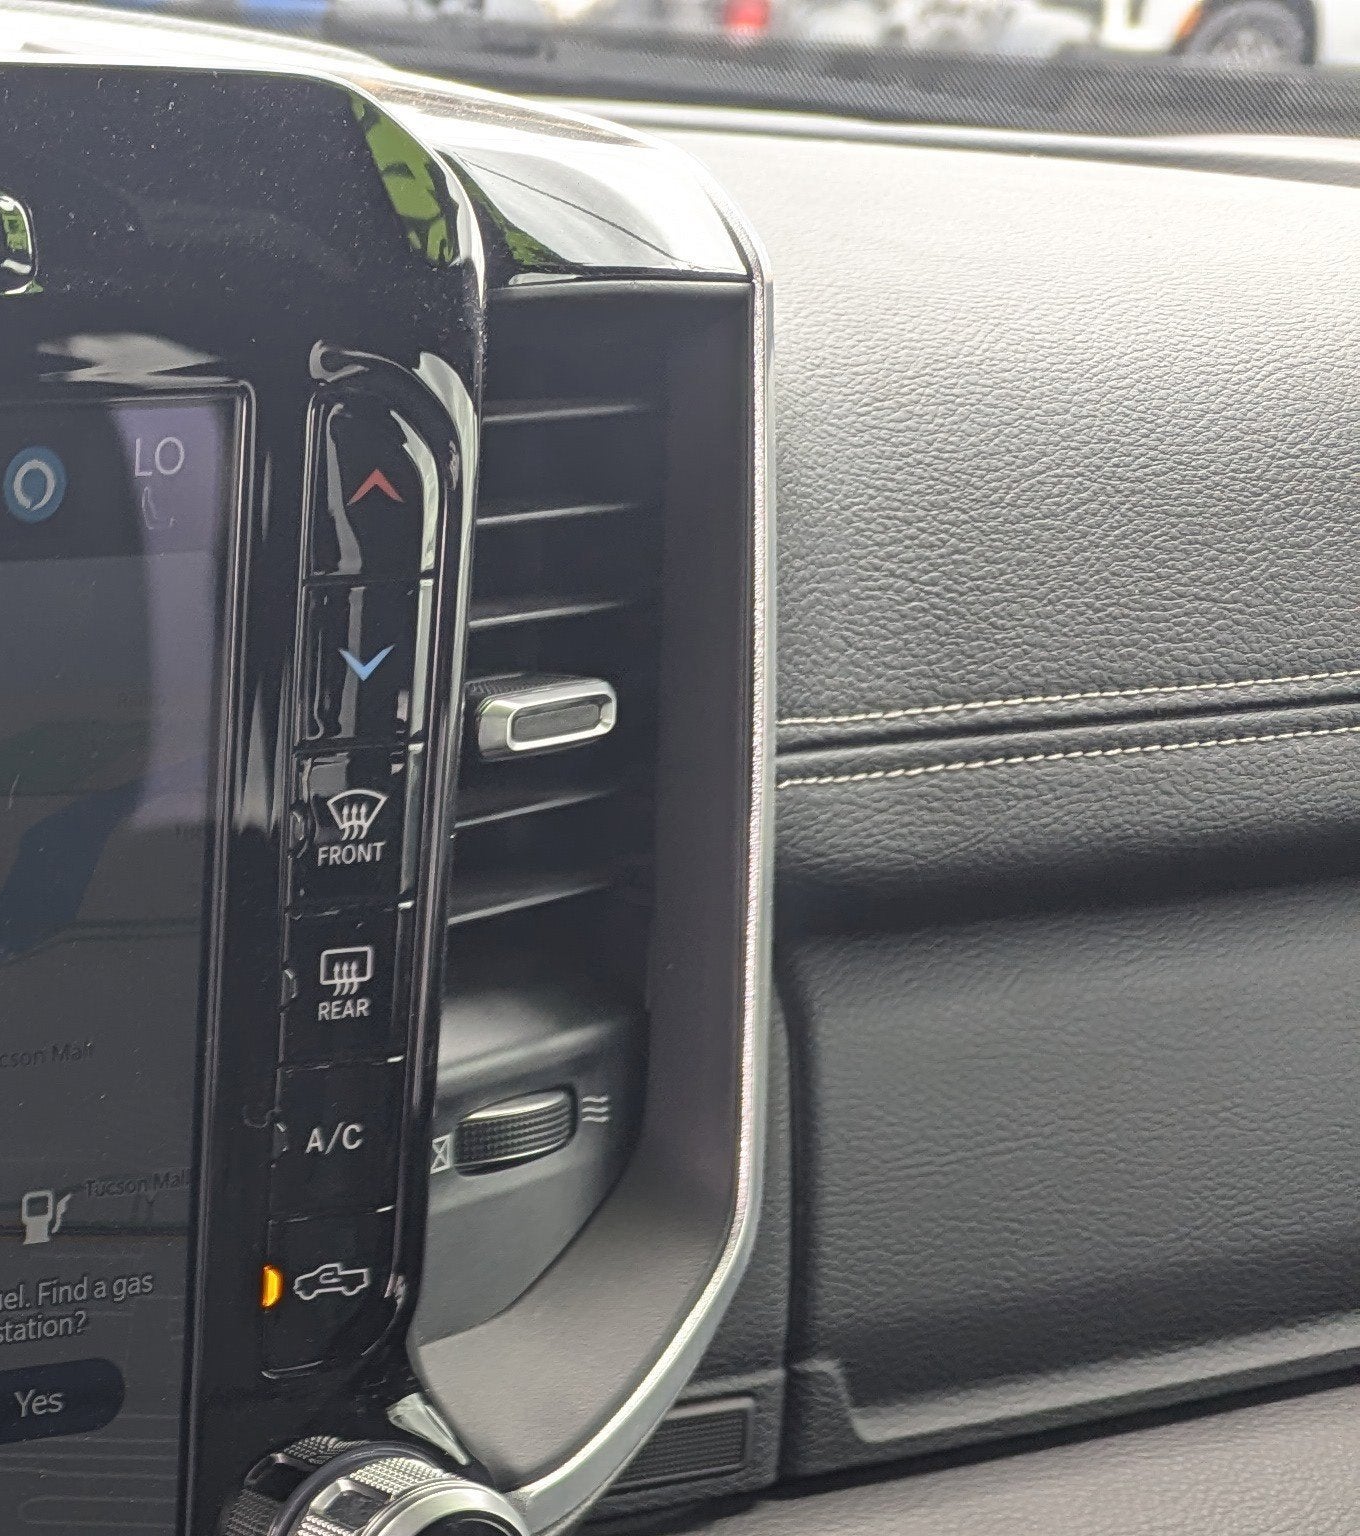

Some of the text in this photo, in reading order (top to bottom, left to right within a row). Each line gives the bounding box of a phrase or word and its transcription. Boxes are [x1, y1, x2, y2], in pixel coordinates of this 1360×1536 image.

[135, 437, 186, 478] LO
[317, 841, 386, 867] FRONT
[317, 999, 370, 1023] REAR
[305, 1121, 364, 1155] A/C
[38, 1278, 88, 1307] Find
[94, 1280, 107, 1298] a
[112, 1274, 154, 1303] gas
[14, 1389, 64, 1419] Yes
